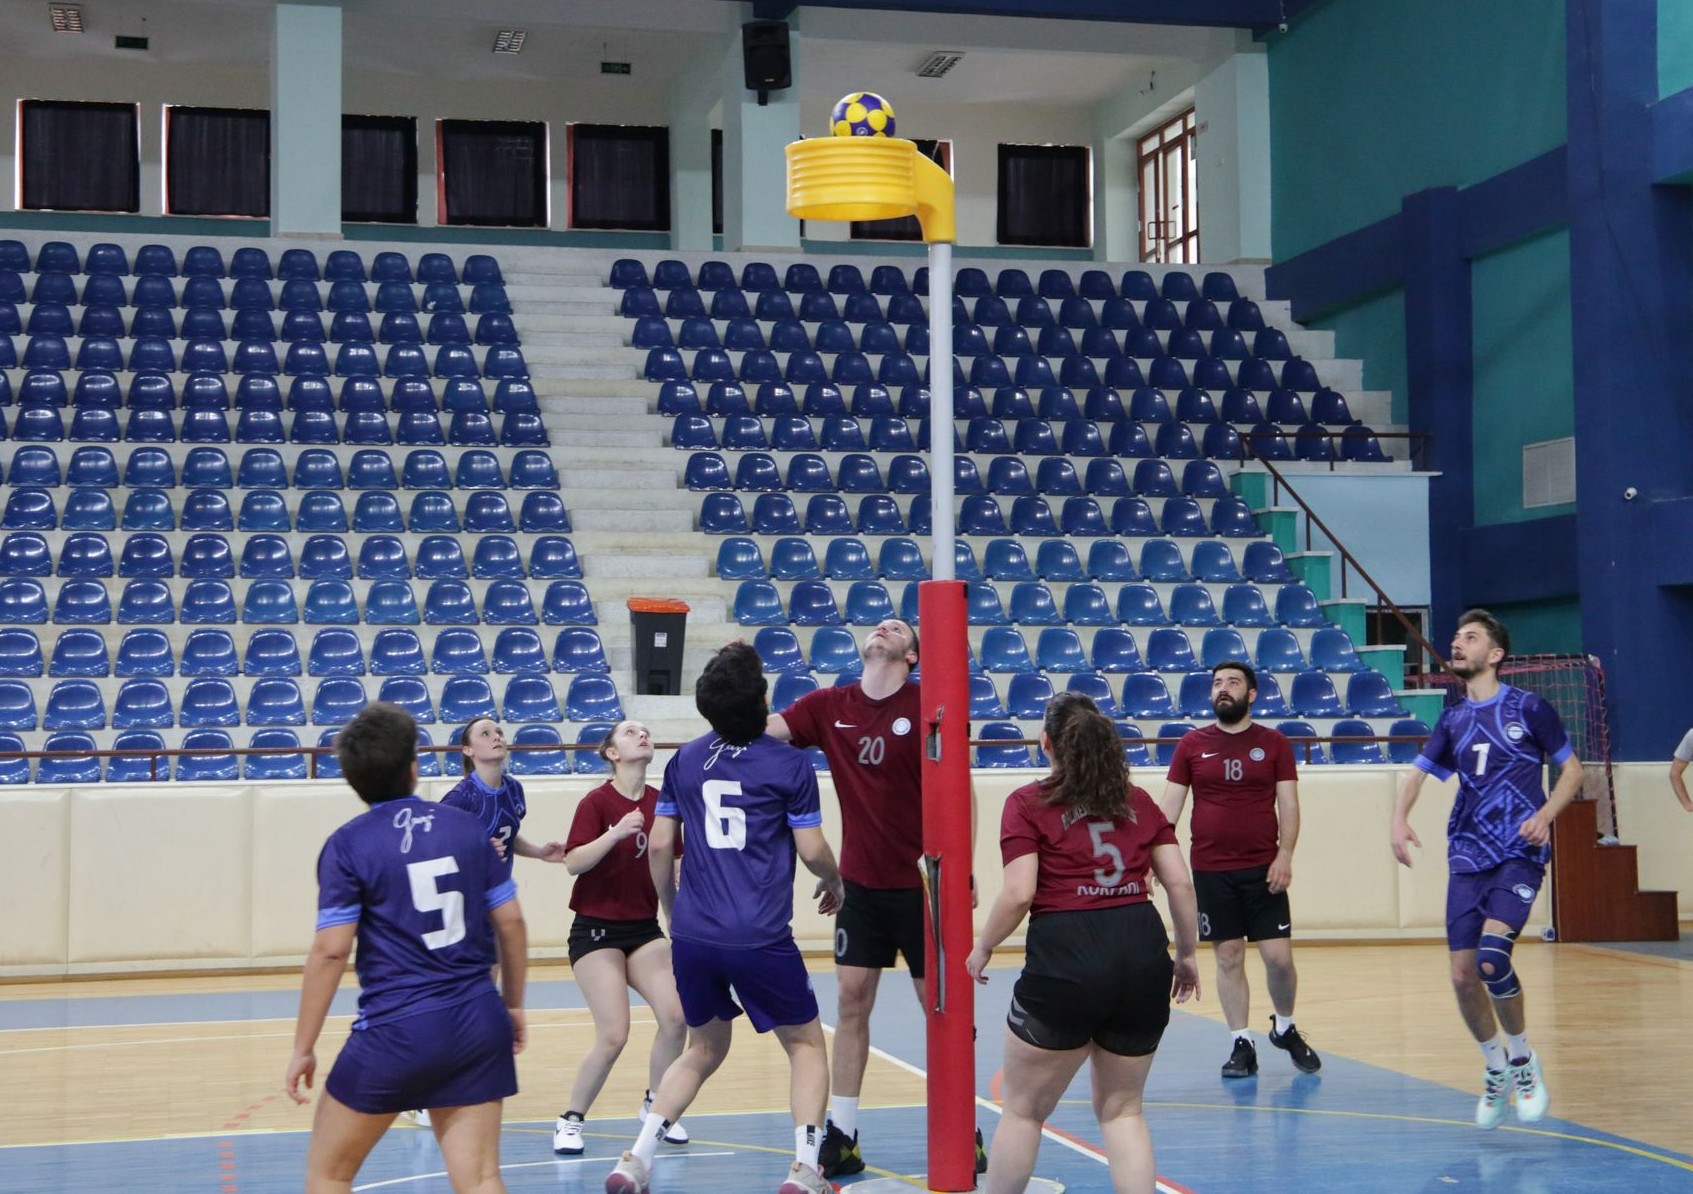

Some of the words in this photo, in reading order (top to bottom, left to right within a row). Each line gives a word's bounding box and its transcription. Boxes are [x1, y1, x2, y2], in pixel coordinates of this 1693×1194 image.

[858, 736, 885, 765] 20
[1472, 743, 1491, 776] 1
[1223, 758, 1243, 781] 18
[702, 779, 747, 851] 6
[635, 831, 648, 859] 9
[1087, 821, 1126, 887] 5
[406, 855, 467, 950] 5
